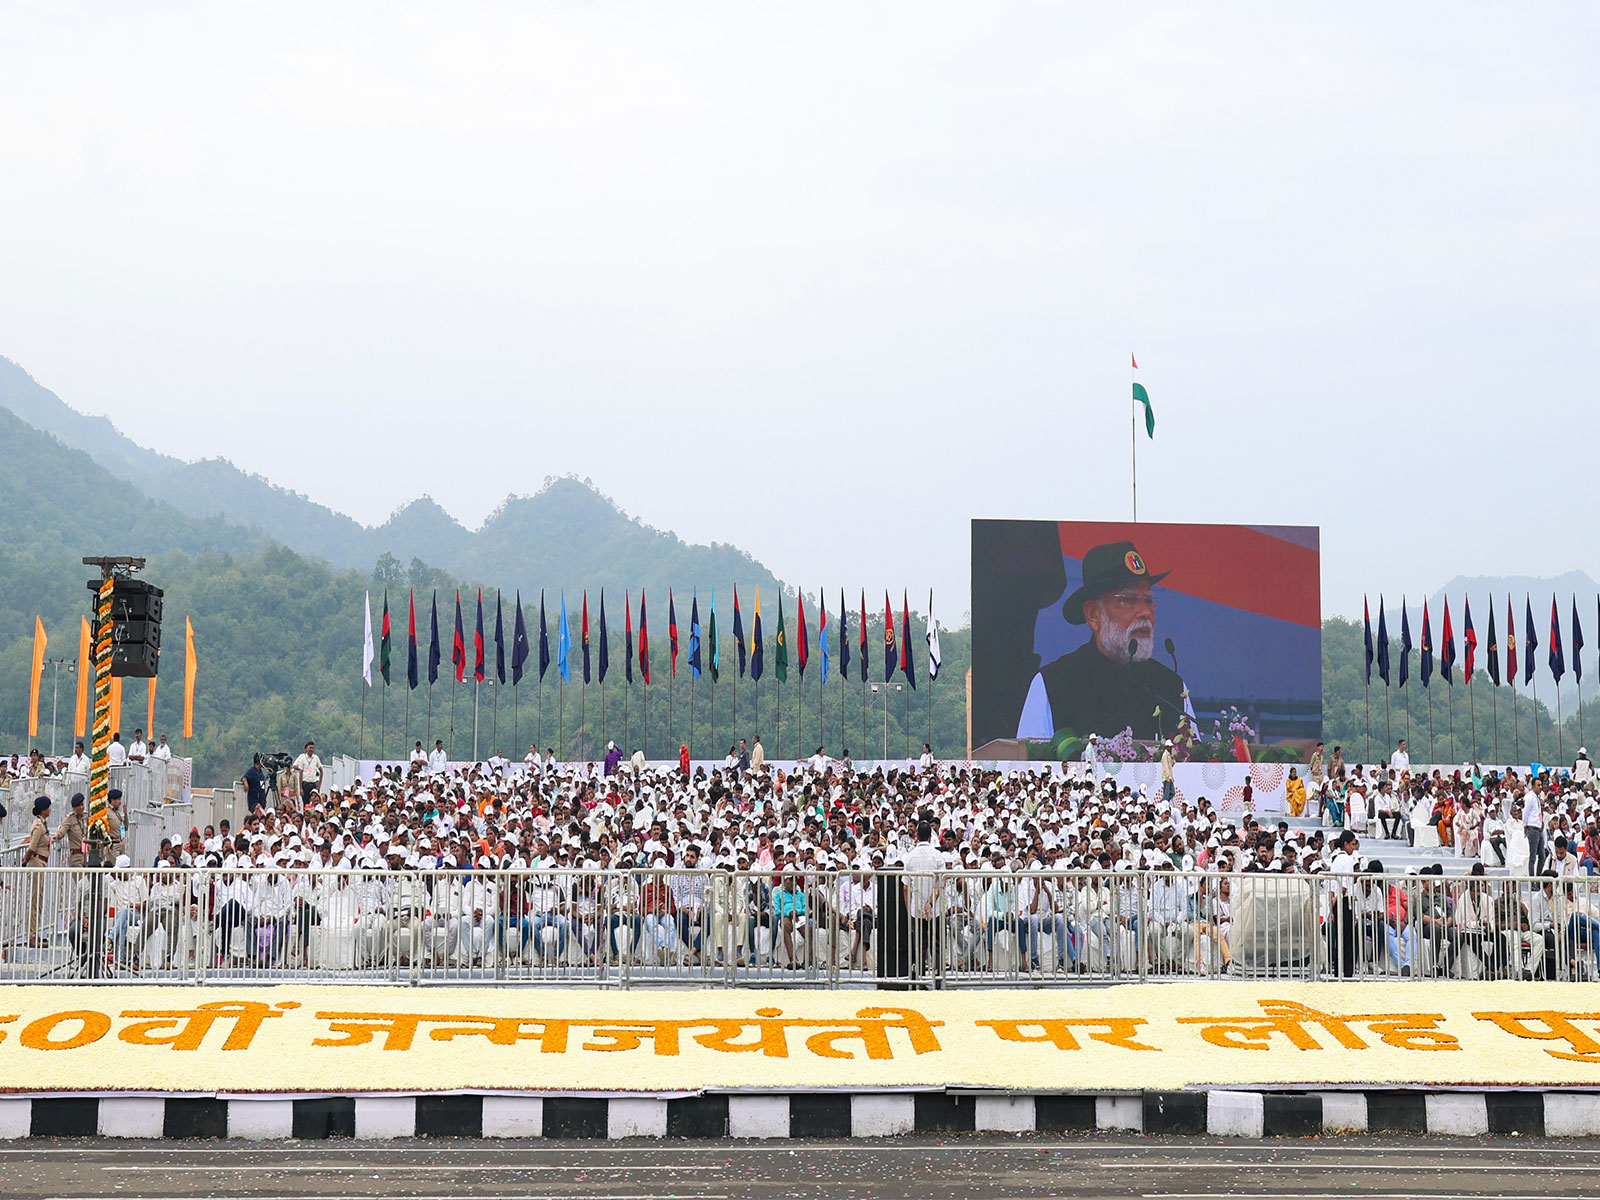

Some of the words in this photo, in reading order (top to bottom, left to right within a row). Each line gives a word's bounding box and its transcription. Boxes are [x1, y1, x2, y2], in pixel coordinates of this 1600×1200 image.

[0, 1000, 303, 1052] 0वीं
[311, 1006, 946, 1060] जन्मजयंती
[973, 1017, 1163, 1052] पर
[1174, 999, 1464, 1052] लौह
